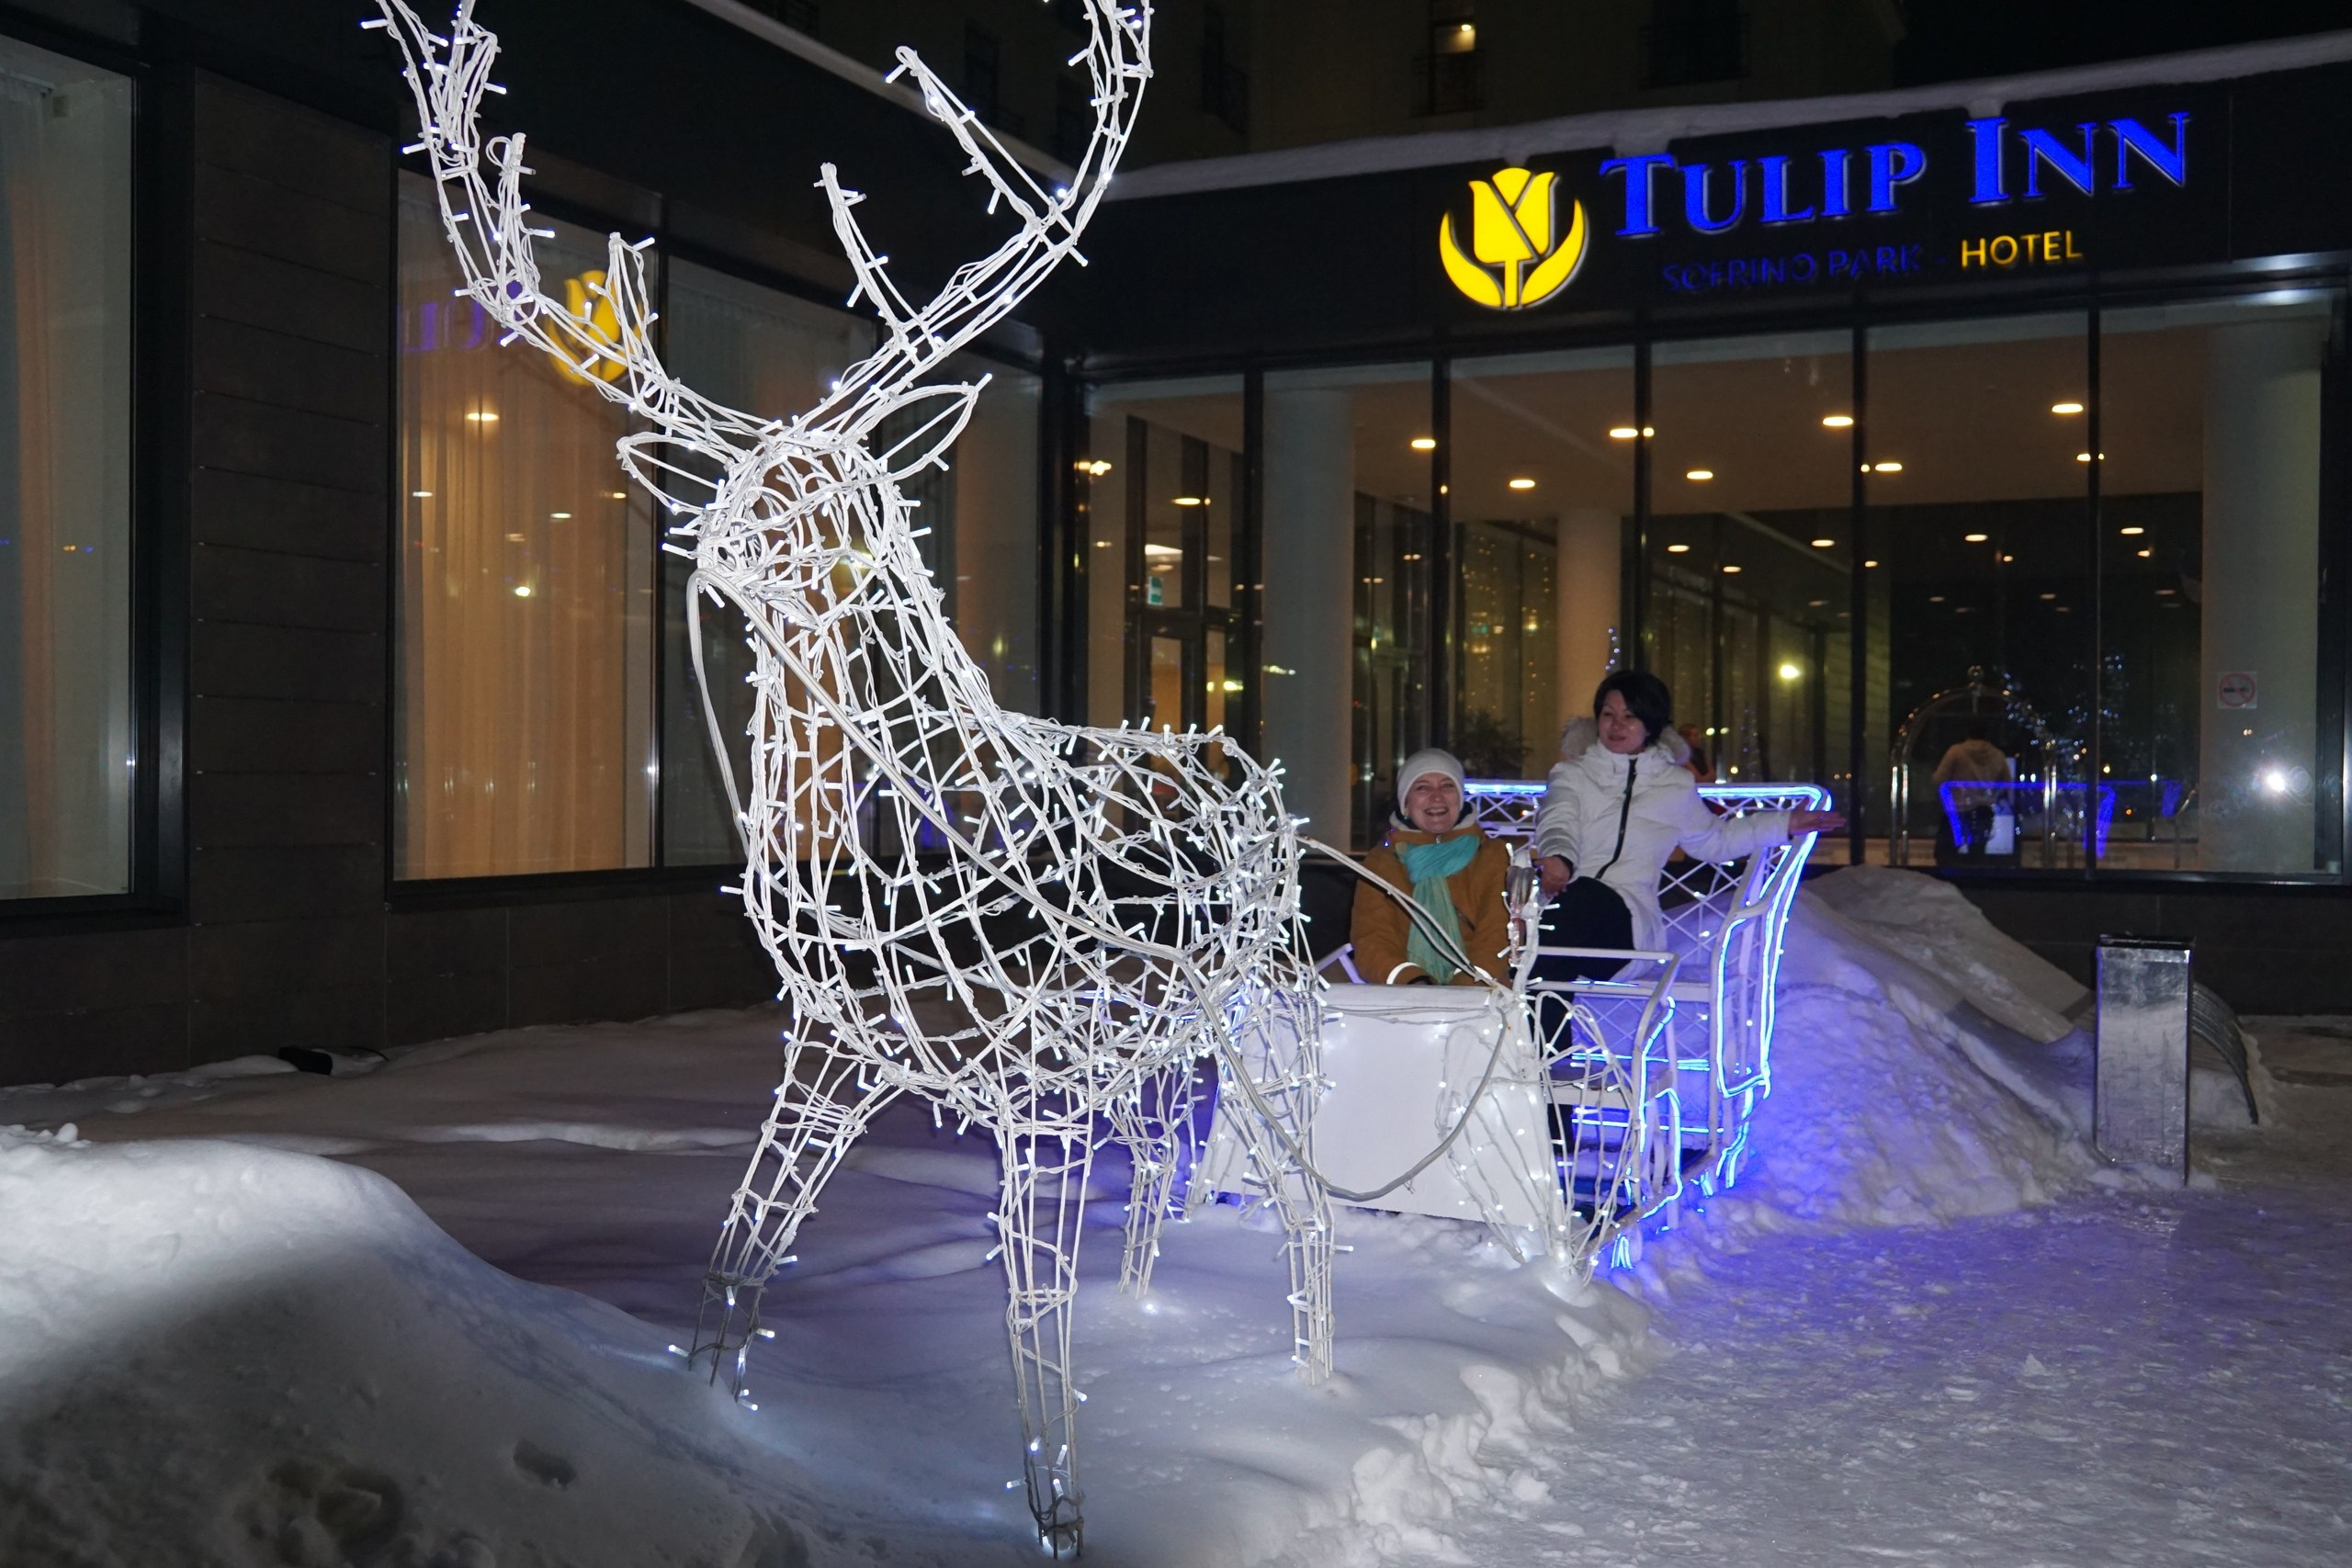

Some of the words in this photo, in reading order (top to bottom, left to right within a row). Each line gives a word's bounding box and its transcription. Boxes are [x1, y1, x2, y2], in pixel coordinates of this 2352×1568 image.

[1599, 141, 1925, 237] TULIP
[1964, 110, 2191, 204] INN
[1662, 253, 1818, 291] SOFRINO
[1826, 243, 1922, 277] PARK
[1961, 230, 2083, 268] HOTEL
